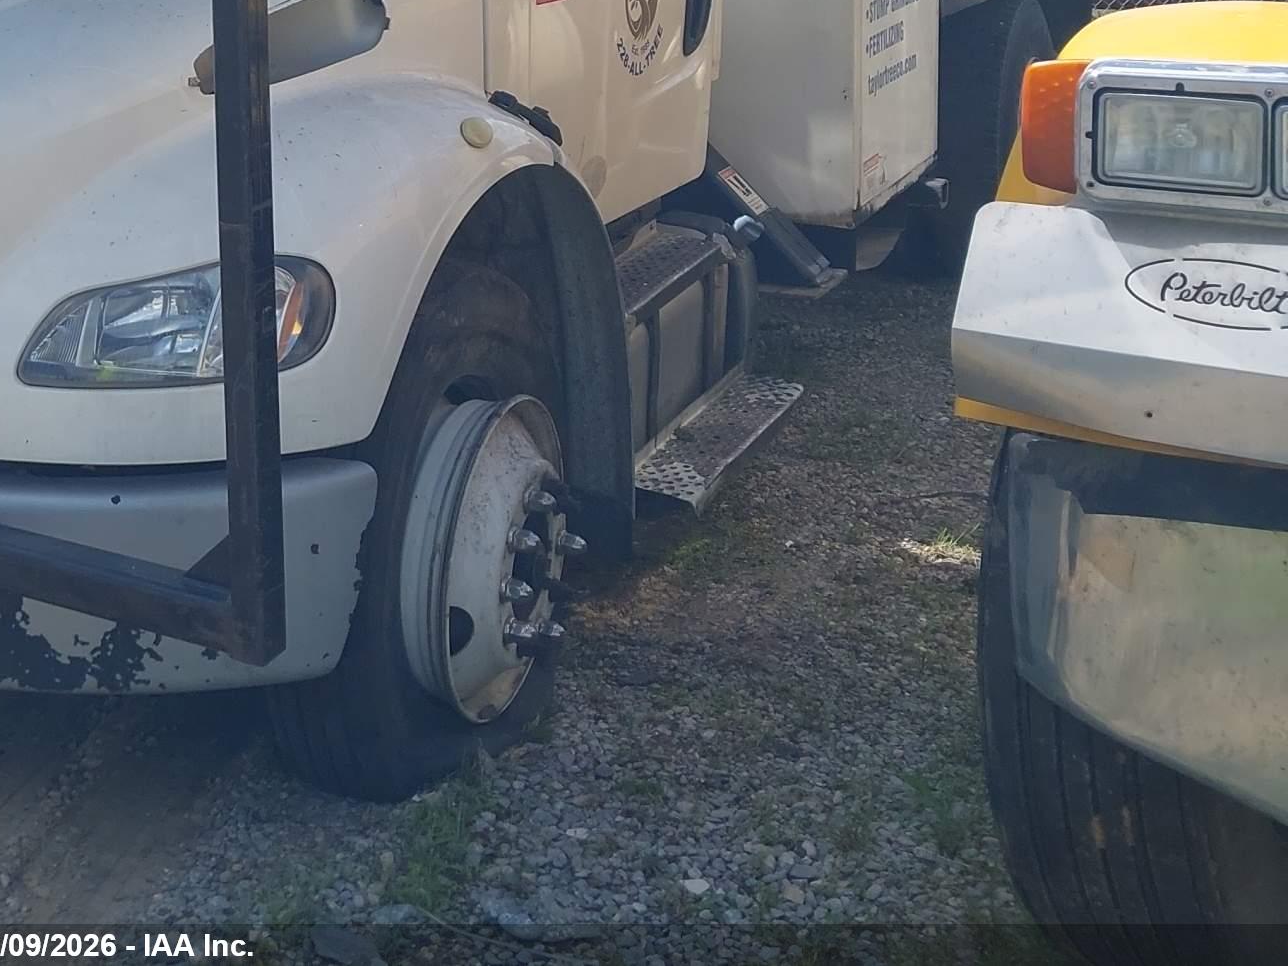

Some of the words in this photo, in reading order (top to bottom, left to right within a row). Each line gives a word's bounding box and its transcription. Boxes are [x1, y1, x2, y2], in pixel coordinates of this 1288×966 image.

[869, 20, 904, 59] FERTILIZING
[867, 53, 917, 97] taylortreeco.com
[1160, 272, 1288, 314] Peterbilt
